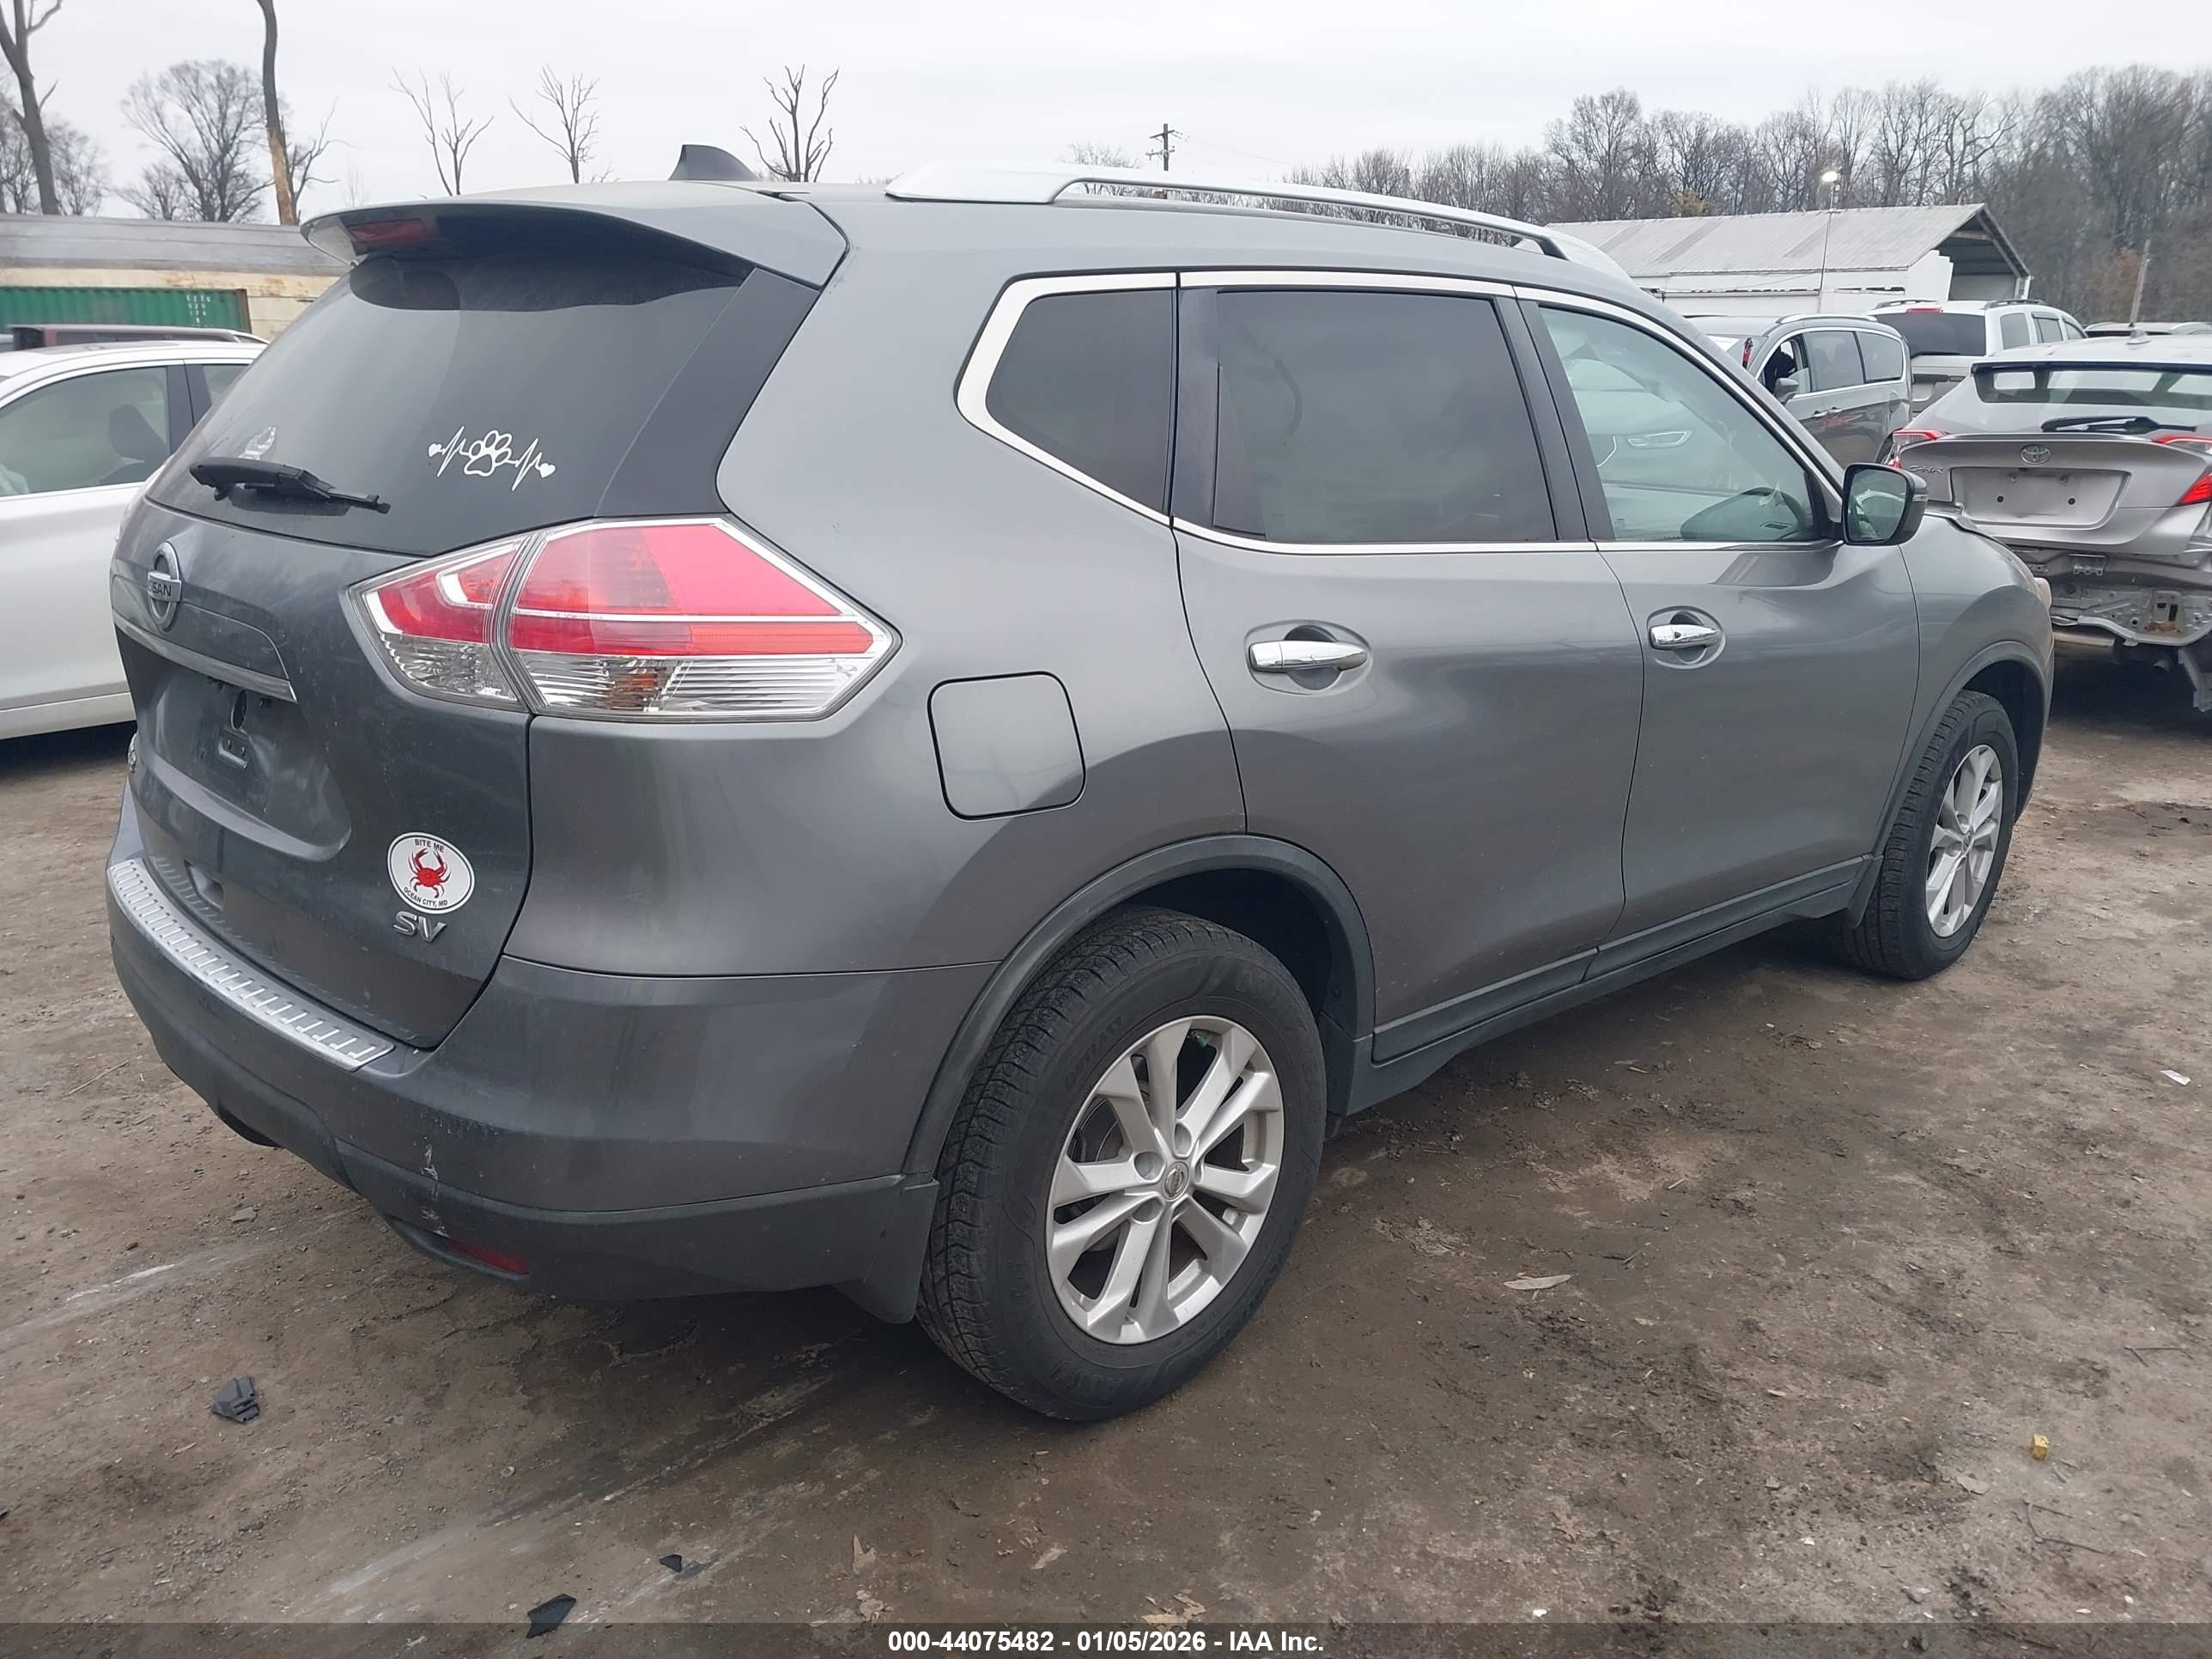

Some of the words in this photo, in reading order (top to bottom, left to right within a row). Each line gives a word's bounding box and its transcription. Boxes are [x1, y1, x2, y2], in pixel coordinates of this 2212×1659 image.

[415, 839, 431, 848] BITE
[434, 842, 445, 853] ME
[404, 887, 422, 903] OCEAN
[422, 898, 437, 907] CITY,
[393, 910, 447, 943] SV
